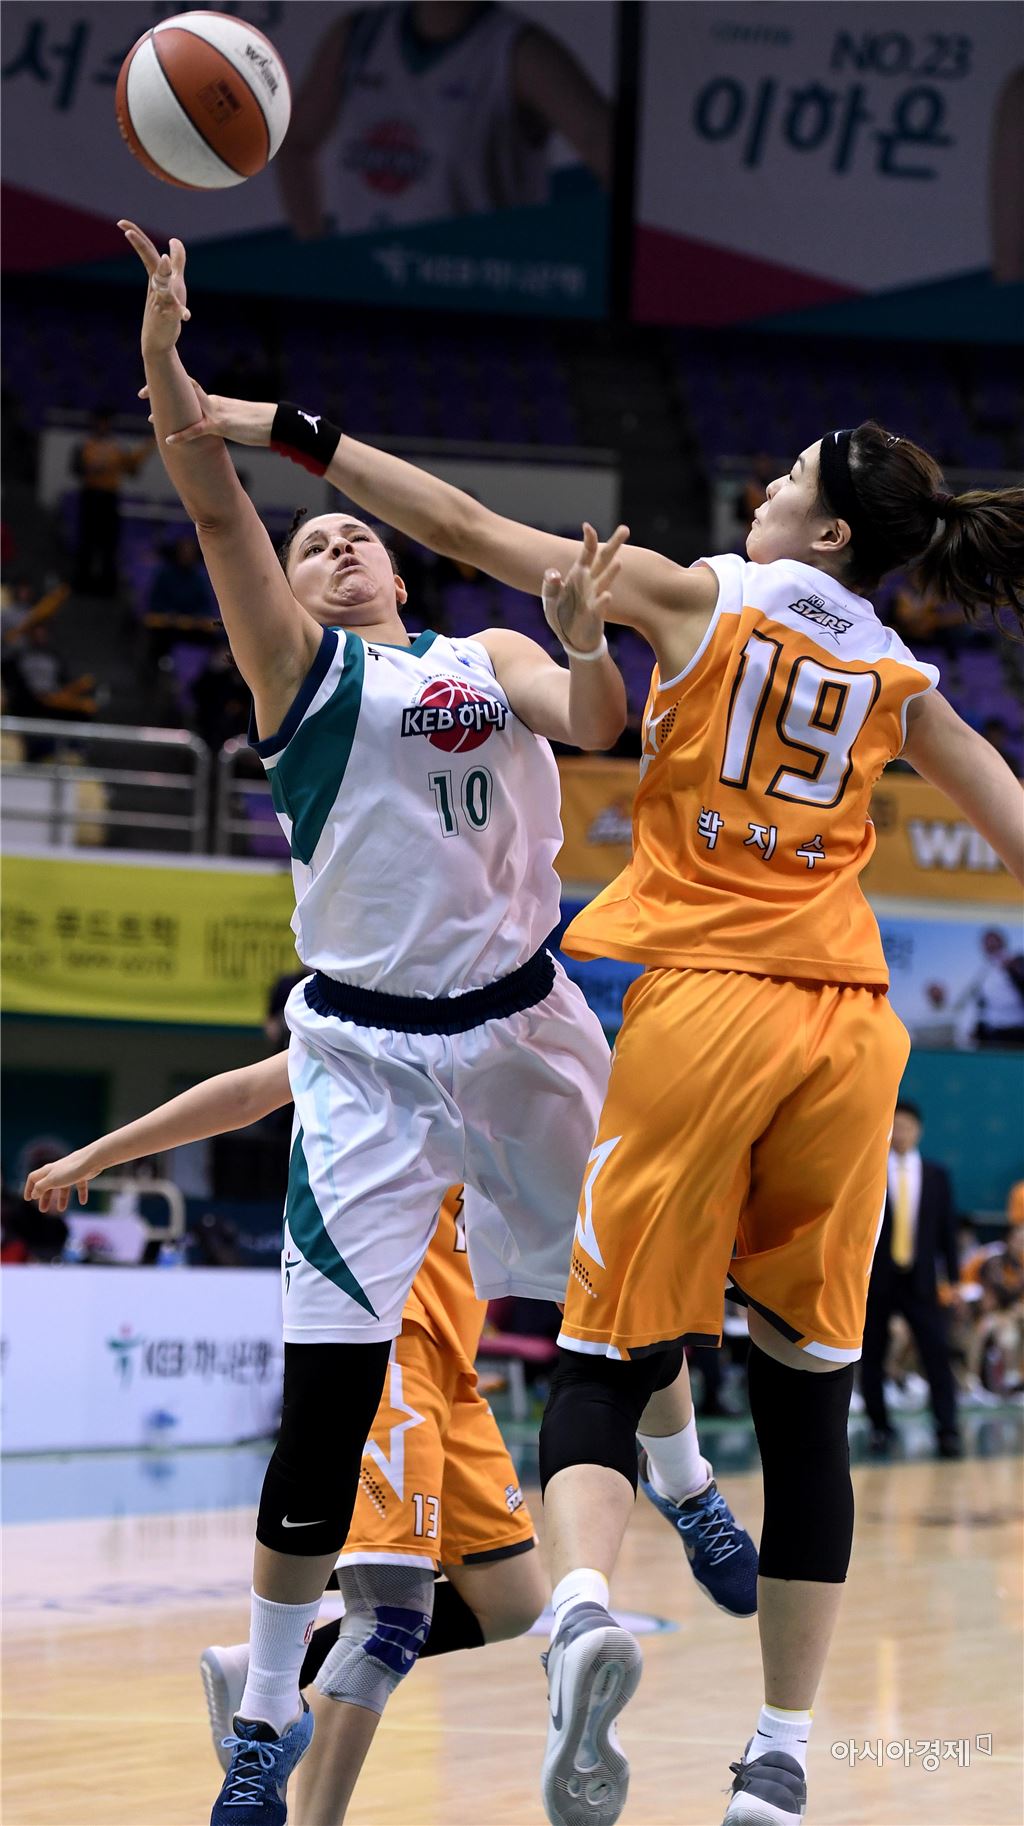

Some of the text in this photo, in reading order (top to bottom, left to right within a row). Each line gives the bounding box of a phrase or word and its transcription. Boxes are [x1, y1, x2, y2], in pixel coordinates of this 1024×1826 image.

[693, 75, 956, 181] 이하은
[787, 598, 855, 633] STARS
[401, 706, 456, 737] KEB
[719, 628, 881, 809] 19
[427, 765, 494, 838] 10
[411, 1493, 441, 1540] 13
